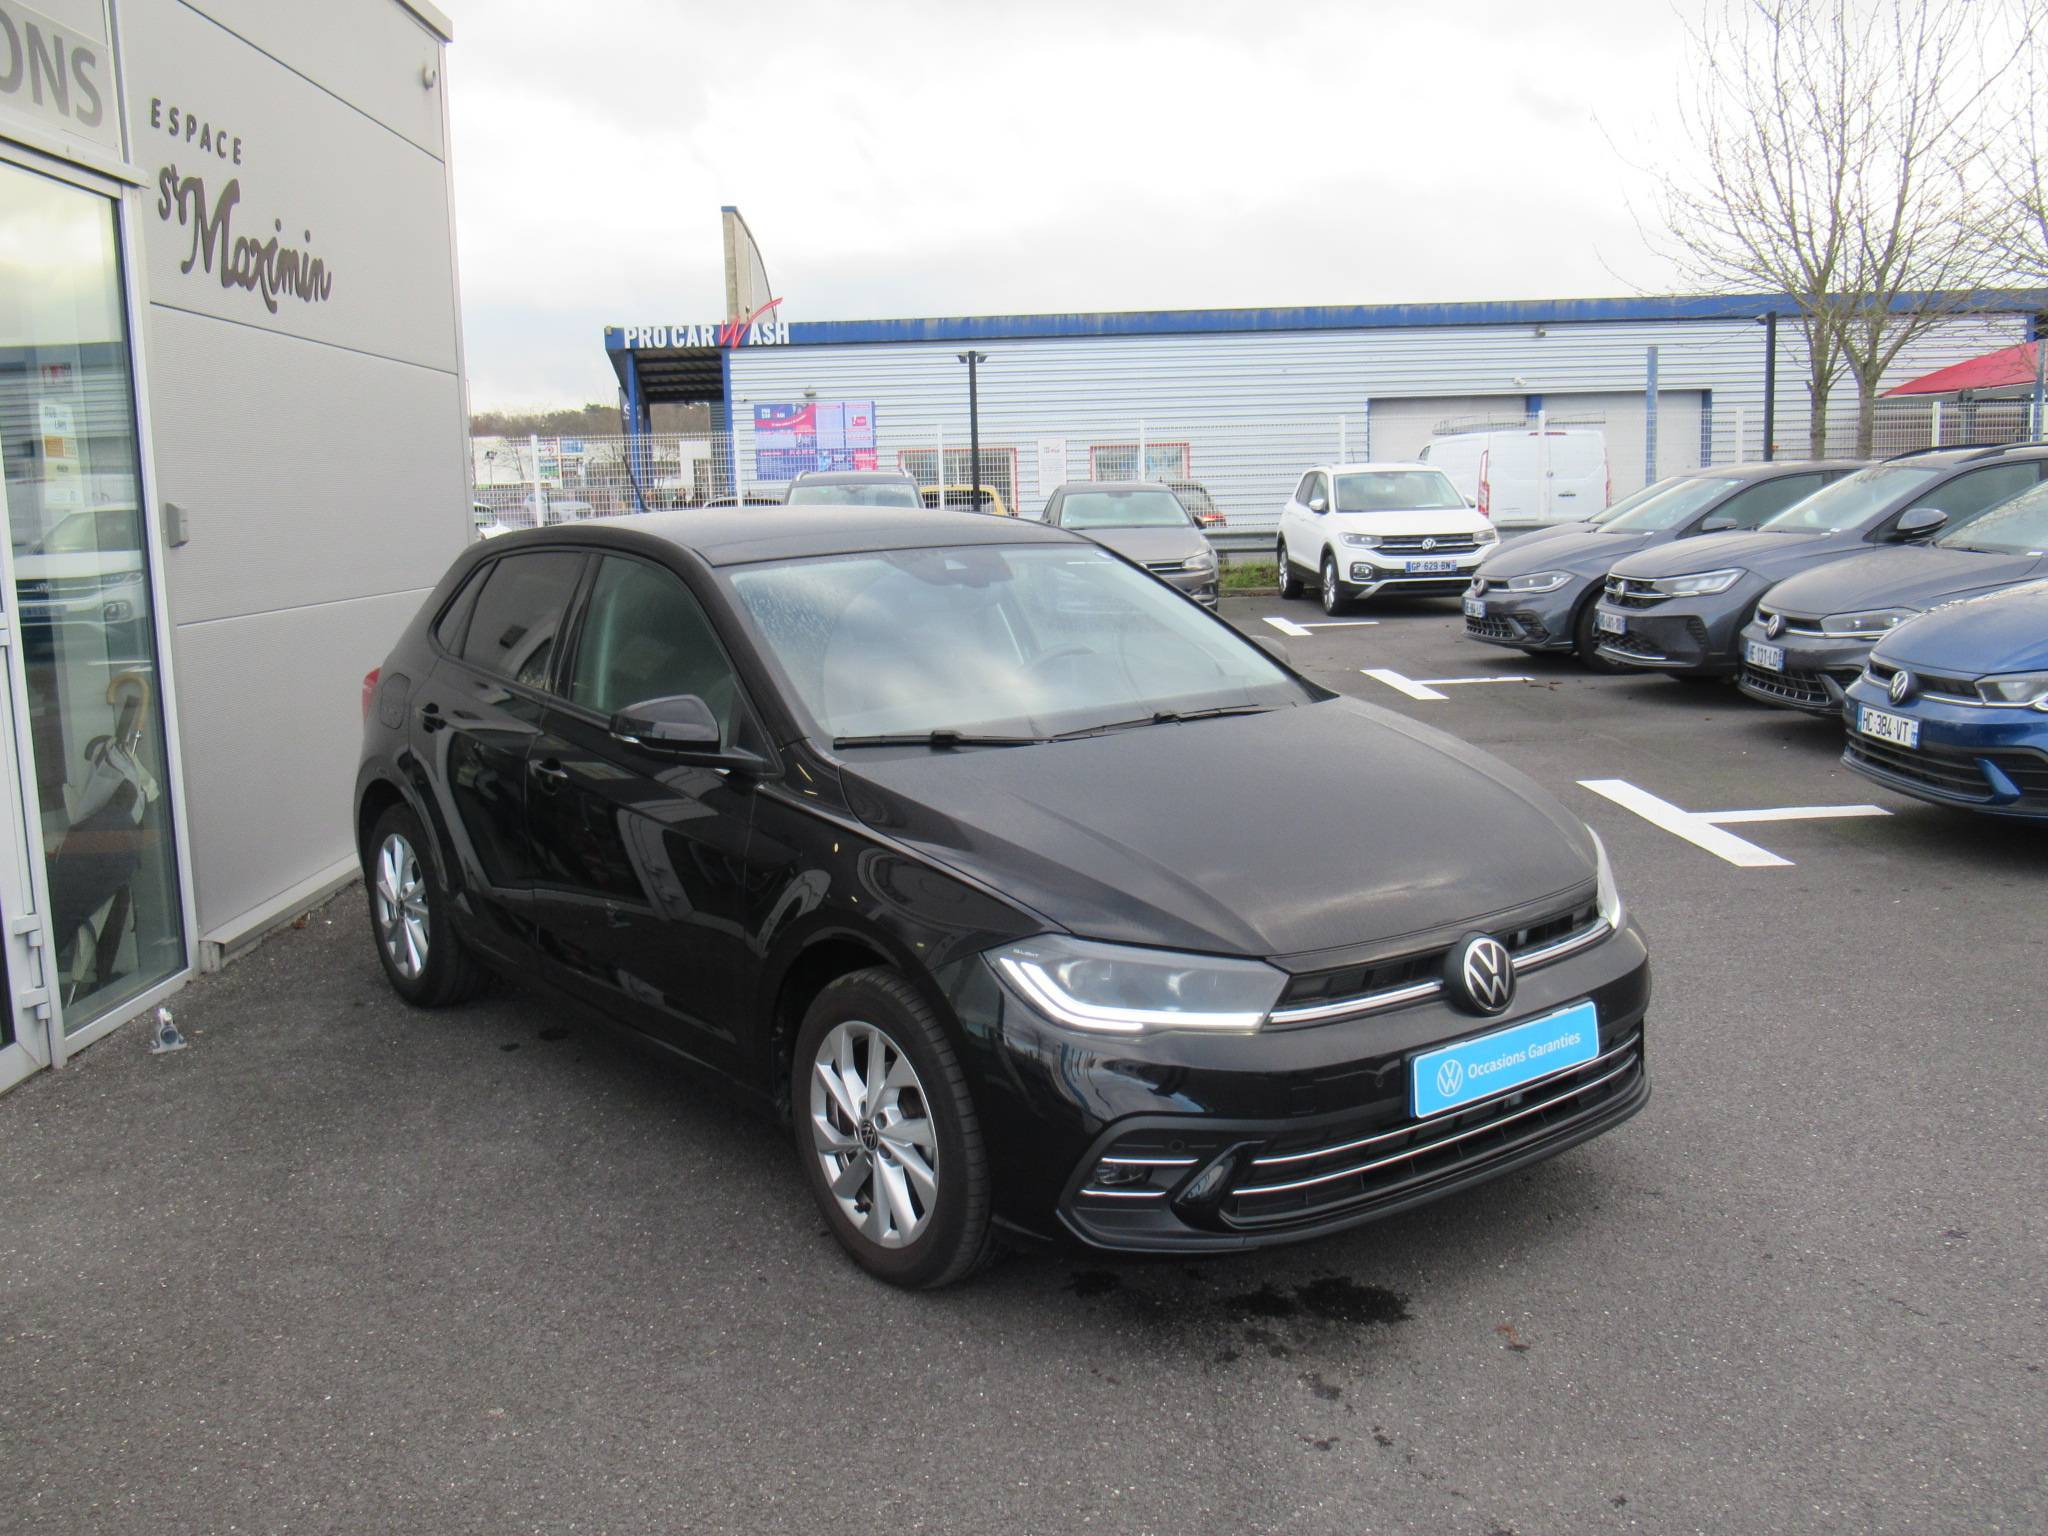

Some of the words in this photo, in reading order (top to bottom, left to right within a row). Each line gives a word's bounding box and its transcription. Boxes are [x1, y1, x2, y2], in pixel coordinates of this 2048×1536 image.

[151, 98, 242, 165] ESPACE
[181, 176, 332, 314] Maximin
[624, 326, 667, 349] PRO
[671, 324, 715, 348] CAR
[1468, 1053, 1527, 1079] Occasions
[1528, 1032, 1582, 1059] Garanties
